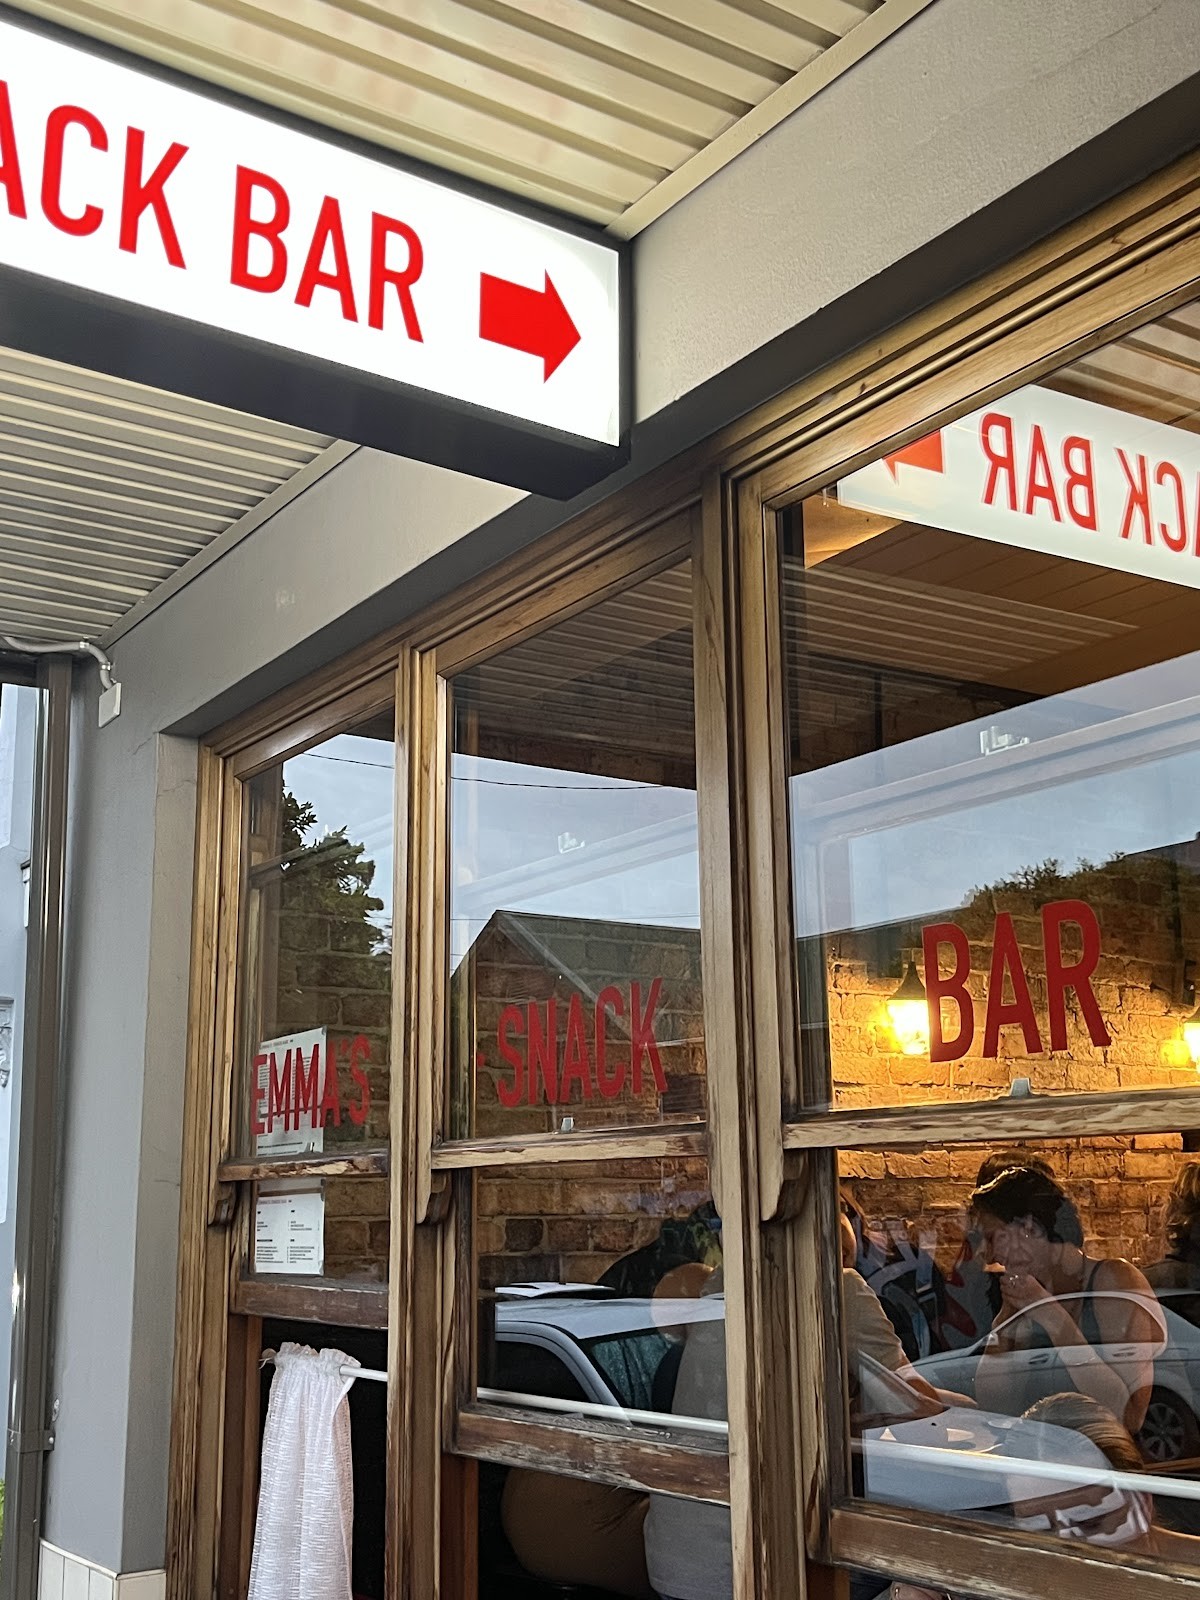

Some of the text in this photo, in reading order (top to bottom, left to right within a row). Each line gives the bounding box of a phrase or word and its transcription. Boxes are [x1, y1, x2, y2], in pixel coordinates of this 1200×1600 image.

[230, 164, 424, 344] BAR
[251, 899, 1112, 1137] EMMA'S SNACK BAR
